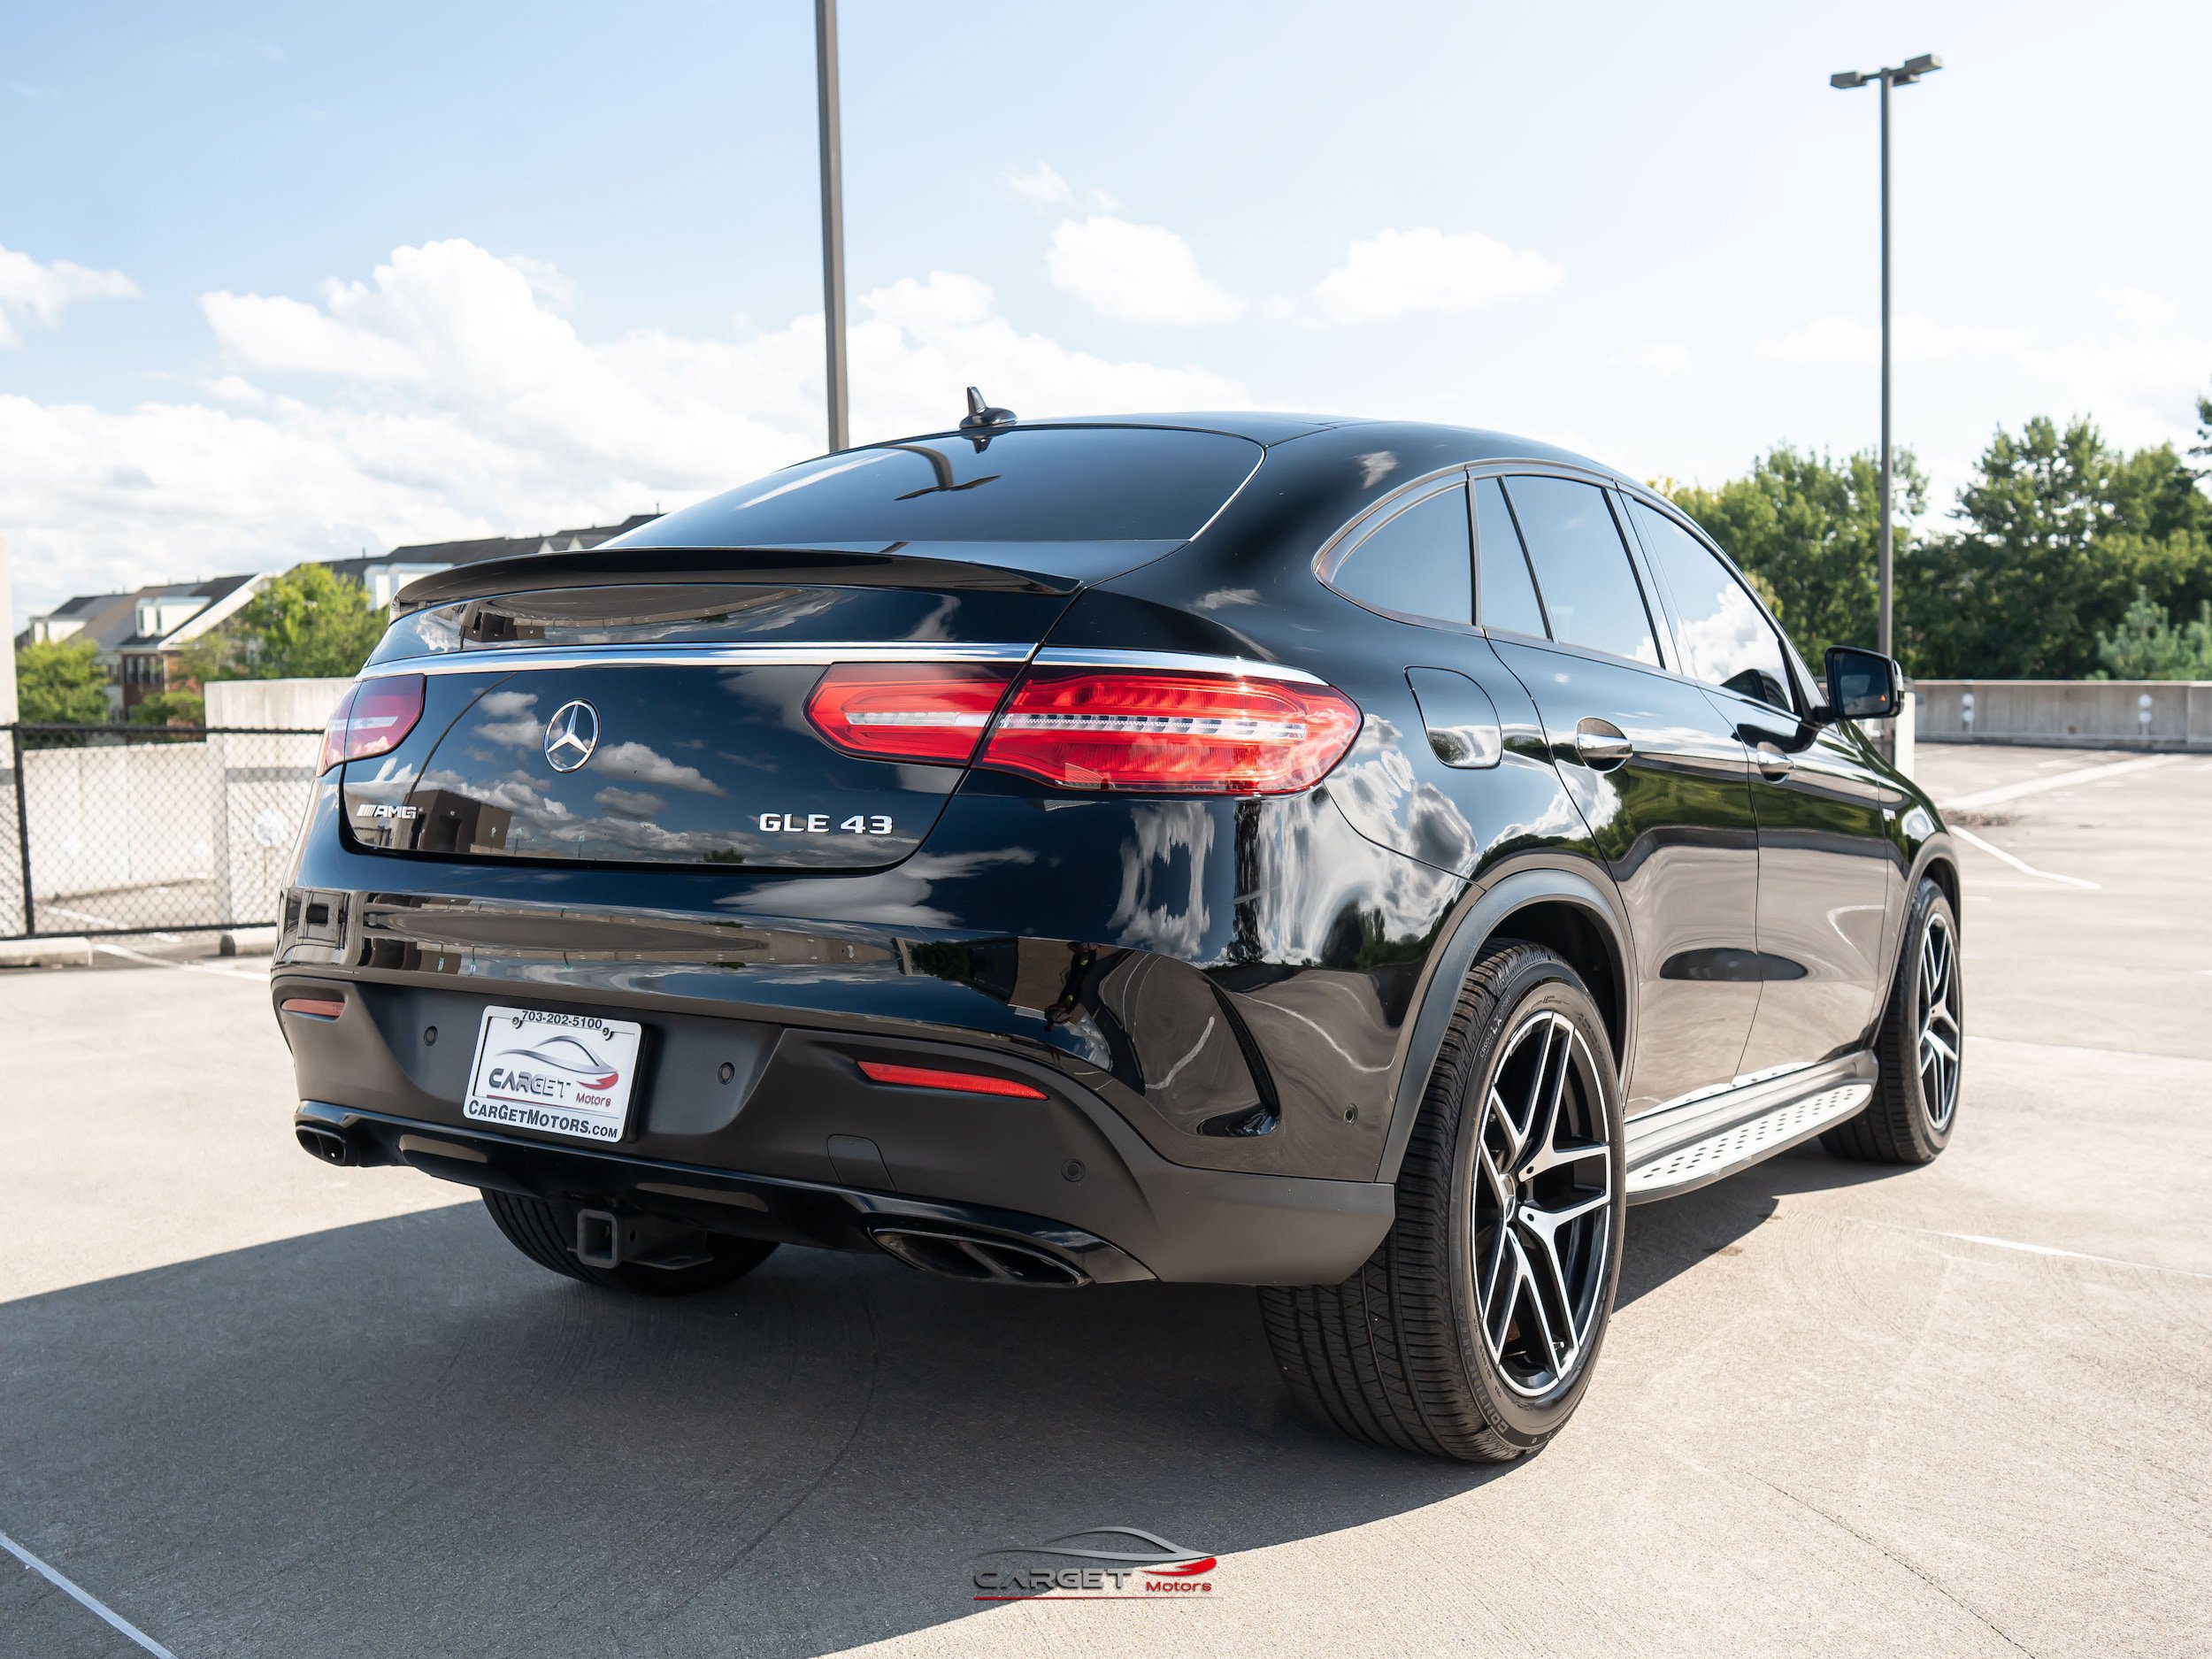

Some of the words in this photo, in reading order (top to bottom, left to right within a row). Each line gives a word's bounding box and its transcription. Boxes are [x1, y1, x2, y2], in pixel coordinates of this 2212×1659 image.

[376, 804, 418, 820] AMG
[758, 812, 829, 833] GLE
[840, 814, 893, 835] 43
[521, 1010, 603, 1030] 703-202-5100
[488, 1068, 572, 1099] CARGET
[575, 1092, 612, 1108] Motors
